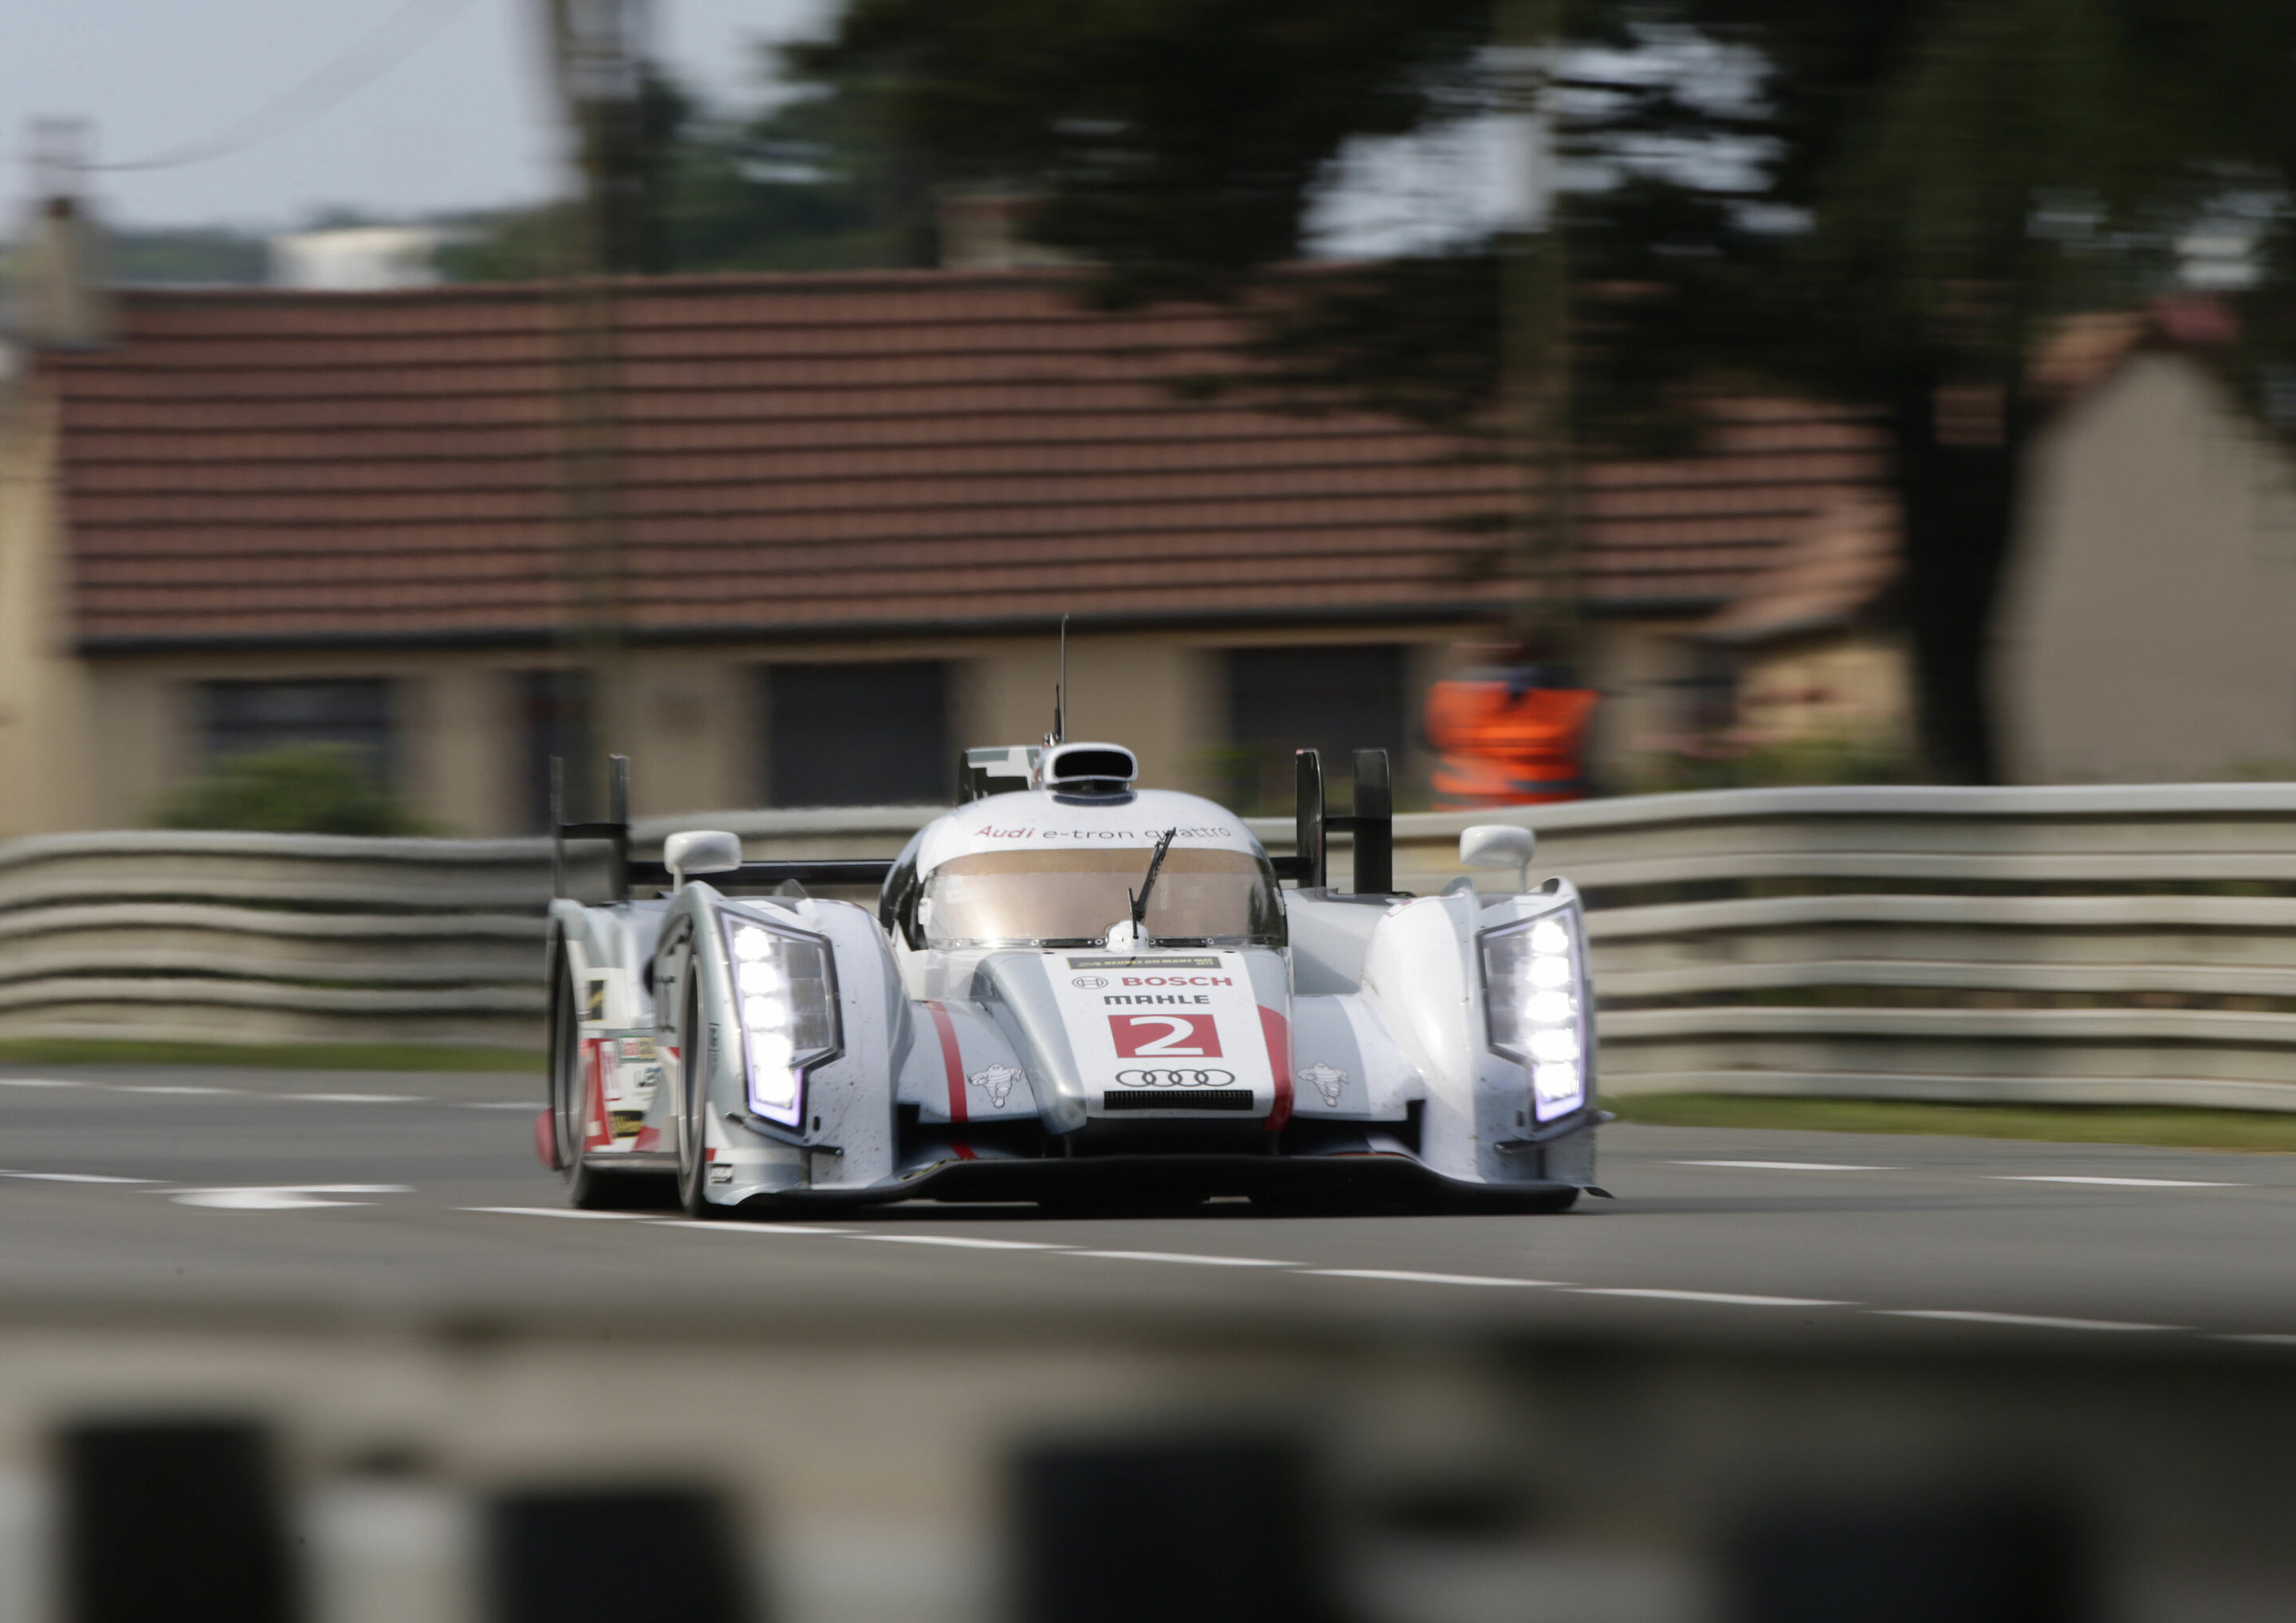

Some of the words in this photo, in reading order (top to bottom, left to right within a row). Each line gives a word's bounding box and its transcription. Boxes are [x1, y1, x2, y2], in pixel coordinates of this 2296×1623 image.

[975, 825, 1036, 839] Audi
[1043, 830, 1134, 839] e-tron
[1122, 977, 1233, 986] BOSCH
[1103, 995, 1210, 1005] MAHLE
[1129, 1016, 1205, 1055] 2
